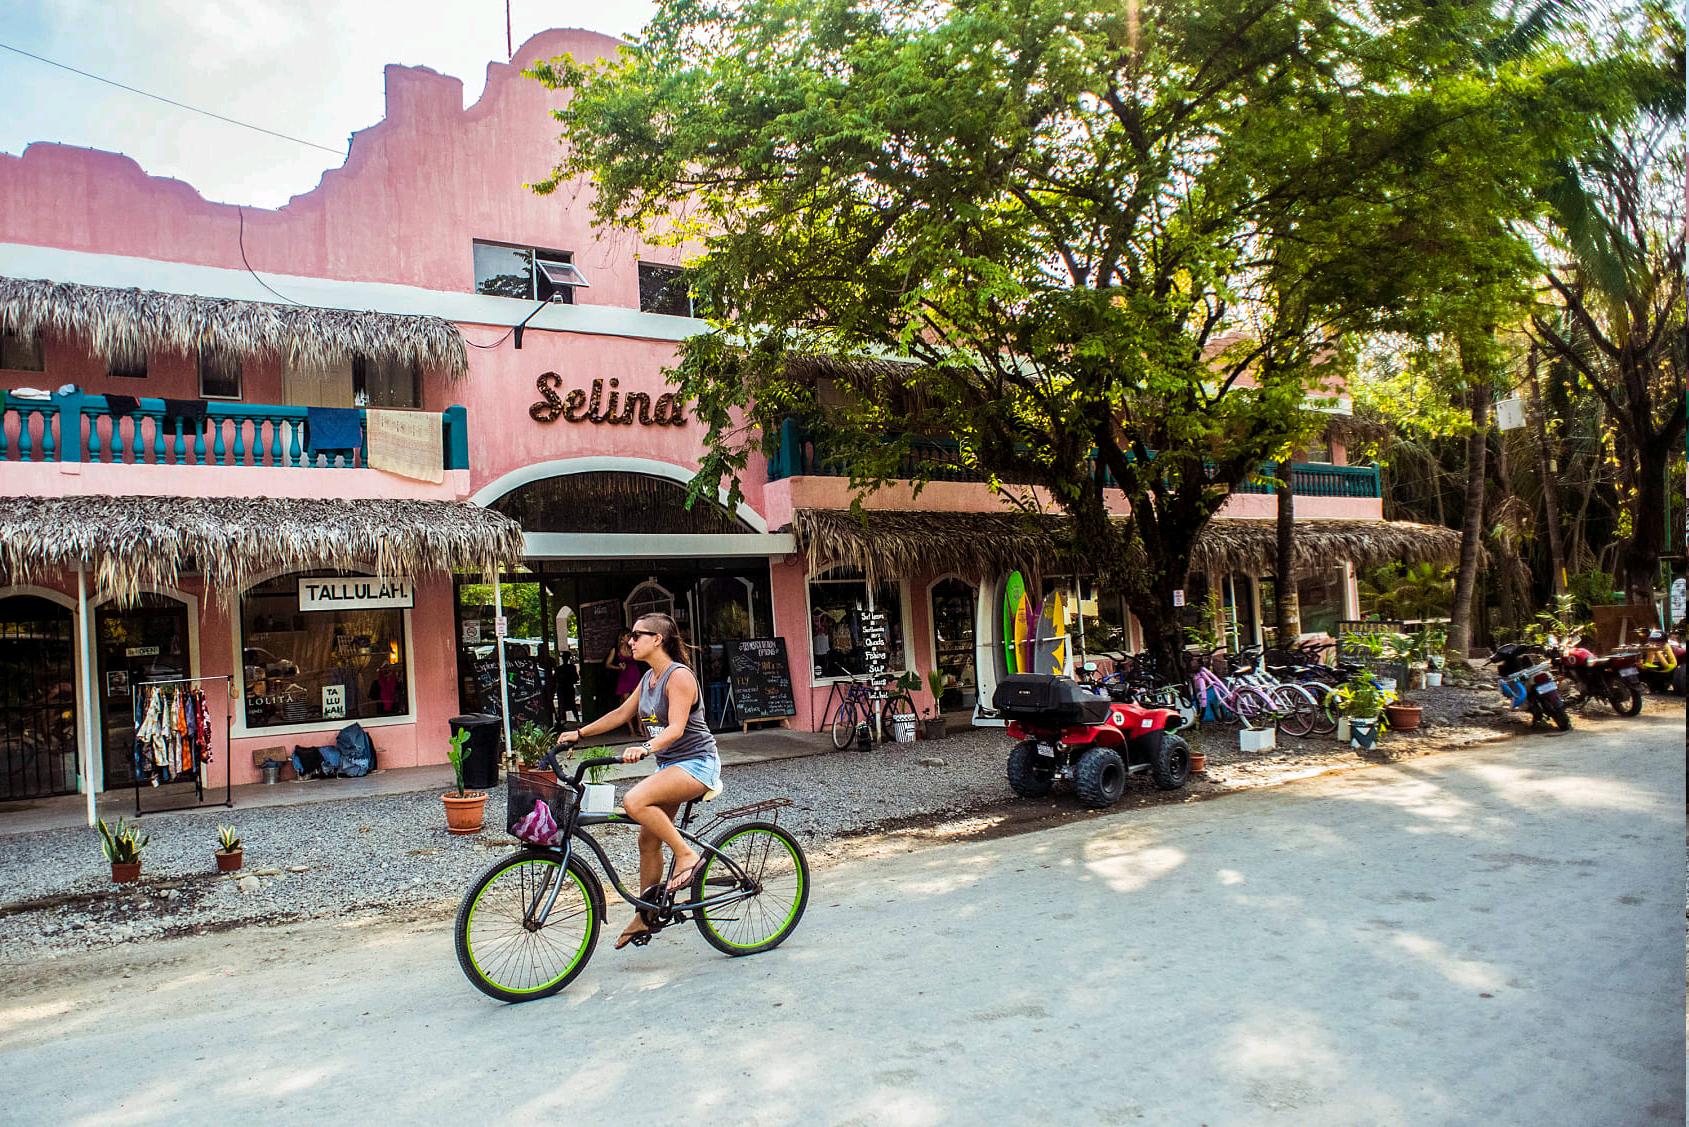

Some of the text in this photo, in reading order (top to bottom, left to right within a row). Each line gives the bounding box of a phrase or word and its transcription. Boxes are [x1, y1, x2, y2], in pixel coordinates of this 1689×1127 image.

[529, 371, 688, 426] Selina
[865, 637, 885, 647] Quads
[864, 651, 886, 661] Fishing
[327, 688, 338, 696] TA
[248, 694, 294, 706] LOLITA
[326, 697, 340, 705] LLU
